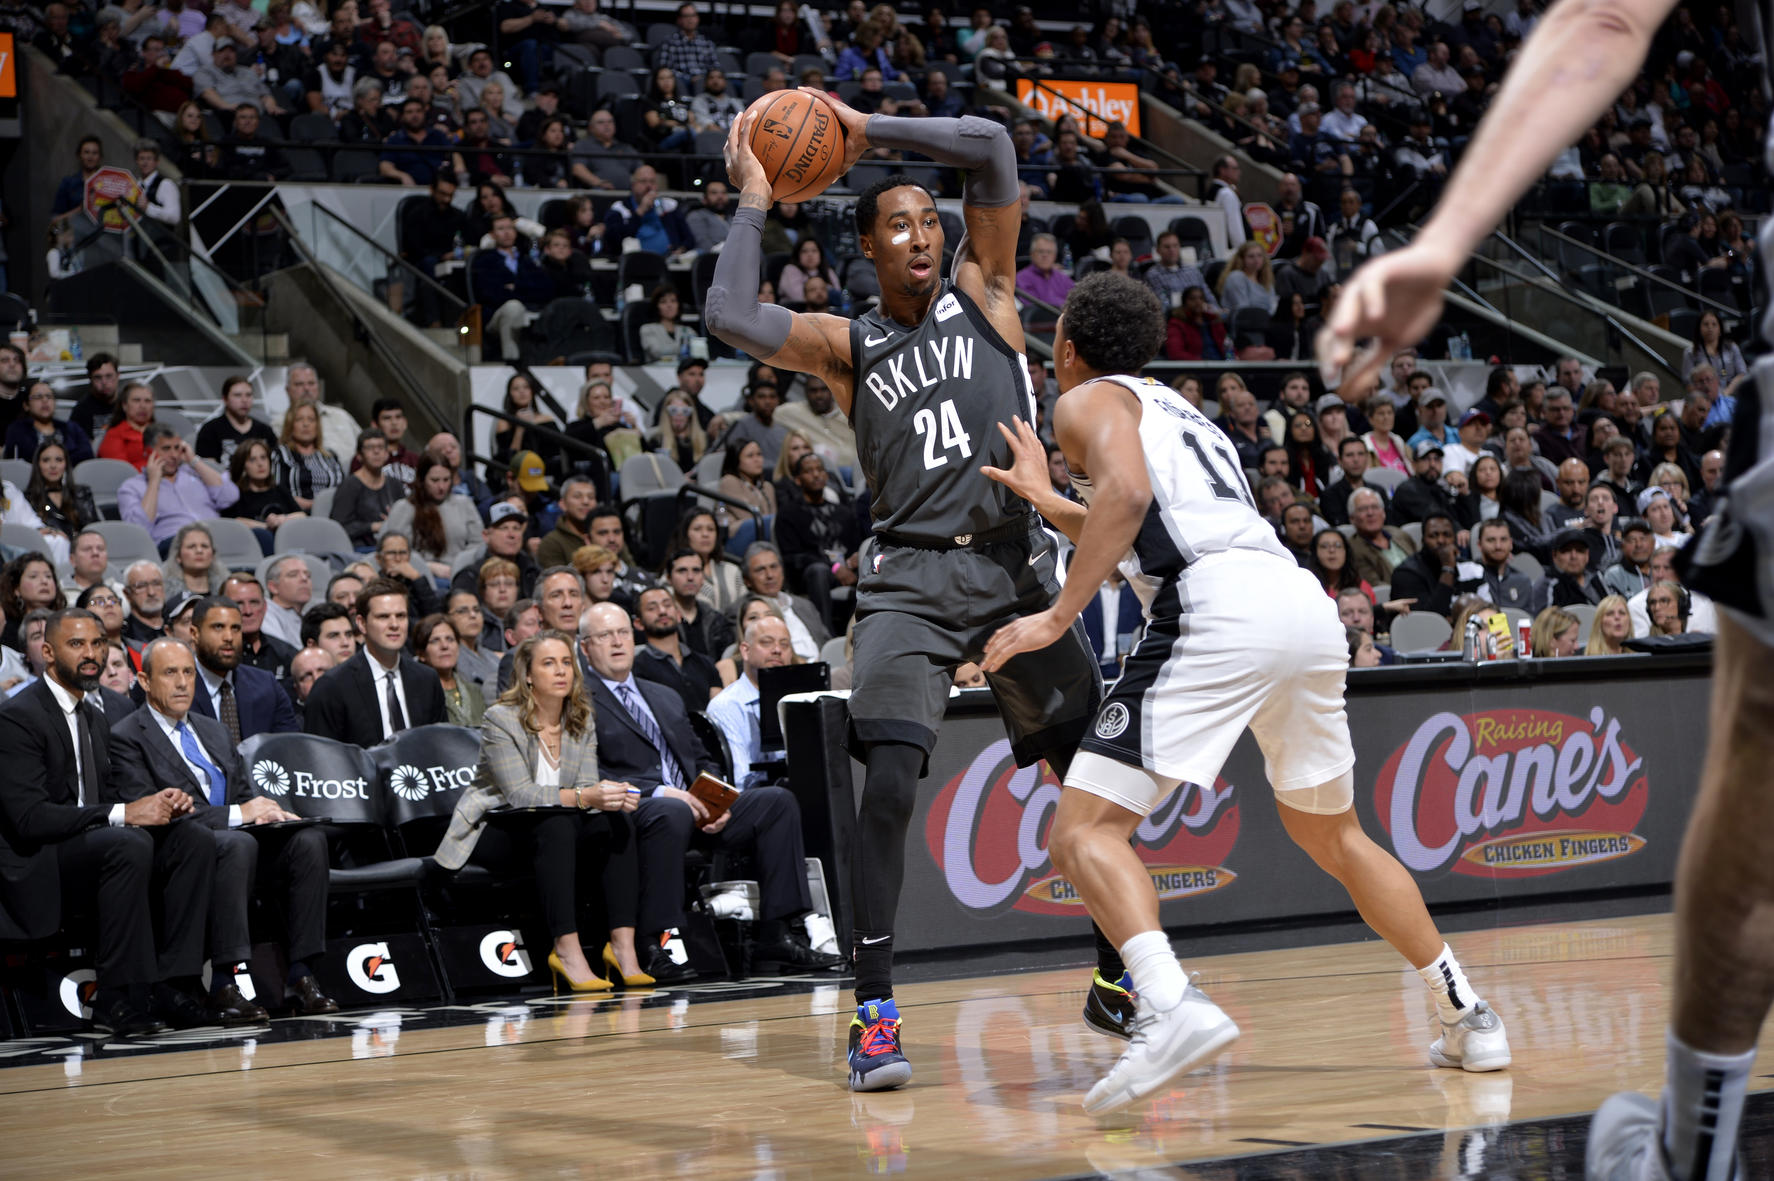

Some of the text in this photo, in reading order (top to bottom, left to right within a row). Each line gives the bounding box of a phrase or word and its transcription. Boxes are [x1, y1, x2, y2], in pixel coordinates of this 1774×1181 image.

[1050, 87, 1134, 126] Ashley
[783, 108, 830, 183] SPALDING
[865, 335, 974, 412] BKLYN
[913, 398, 973, 471] 24
[1179, 428, 1258, 511] 11
[1475, 713, 1564, 748] Raising
[293, 770, 370, 800] Frost
[427, 764, 478, 793] Fro
[1390, 705, 1643, 872] Cane's
[1482, 842, 1555, 863] CHICKEN
[1559, 836, 1629, 858] FINGERS
[1151, 869, 1217, 891] INGERS
[346, 941, 401, 994] G
[478, 929, 534, 978] G
